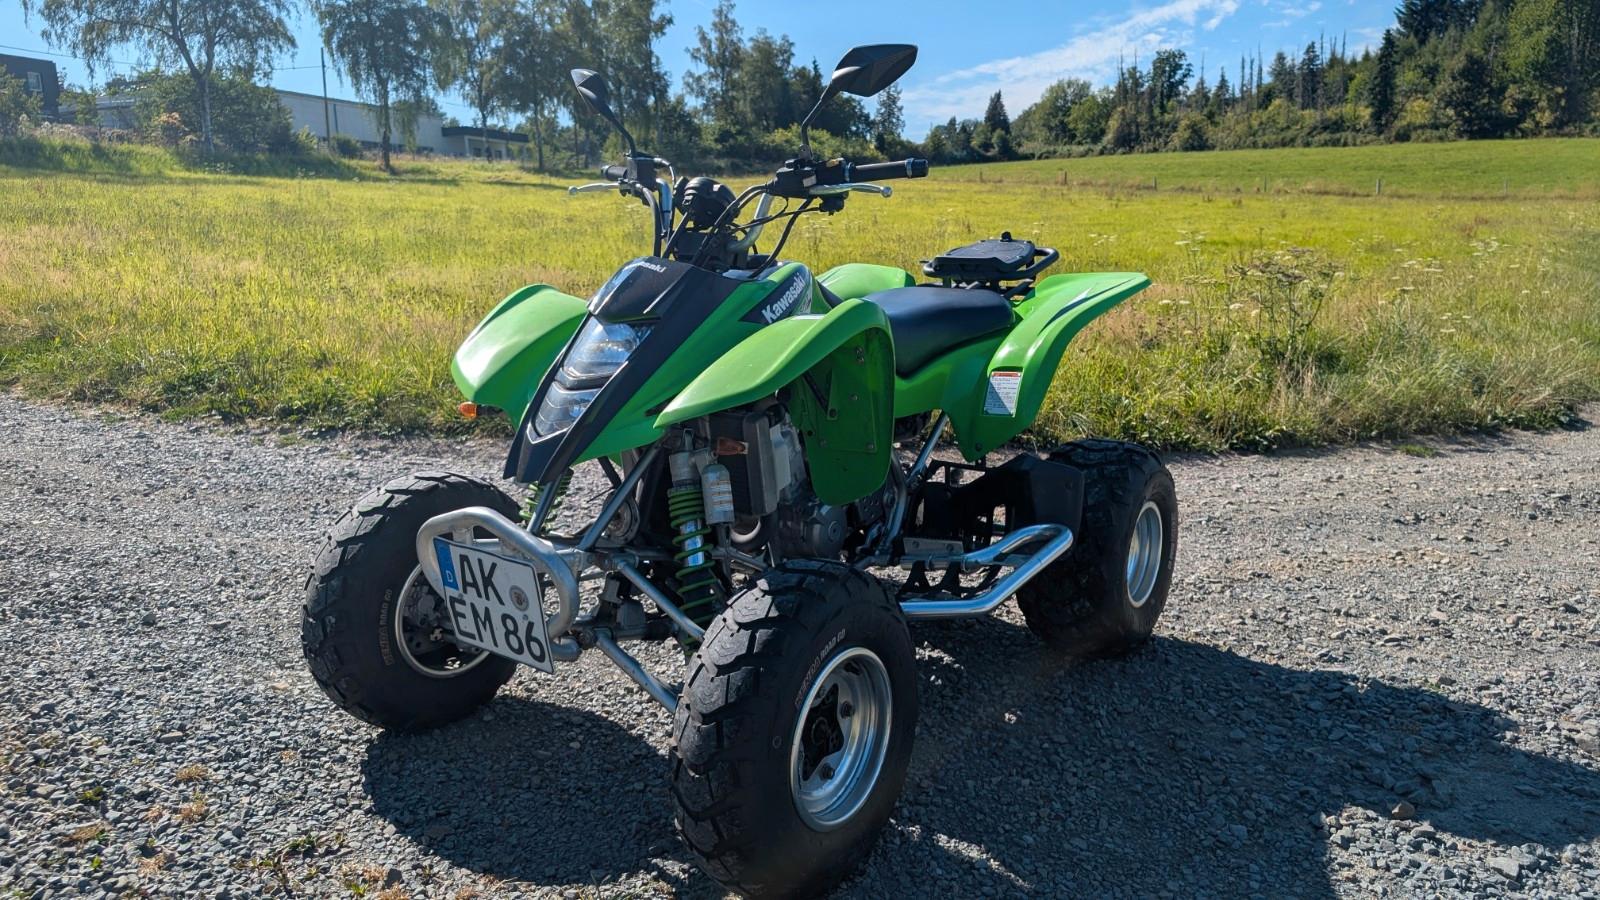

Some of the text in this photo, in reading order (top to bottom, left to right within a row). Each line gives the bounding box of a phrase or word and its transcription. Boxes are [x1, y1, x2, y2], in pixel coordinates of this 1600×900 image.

[761, 272, 805, 323] Kawasaki
[445, 570, 454, 583] D
[459, 554, 505, 606] AK
[449, 596, 546, 663] EM 86
